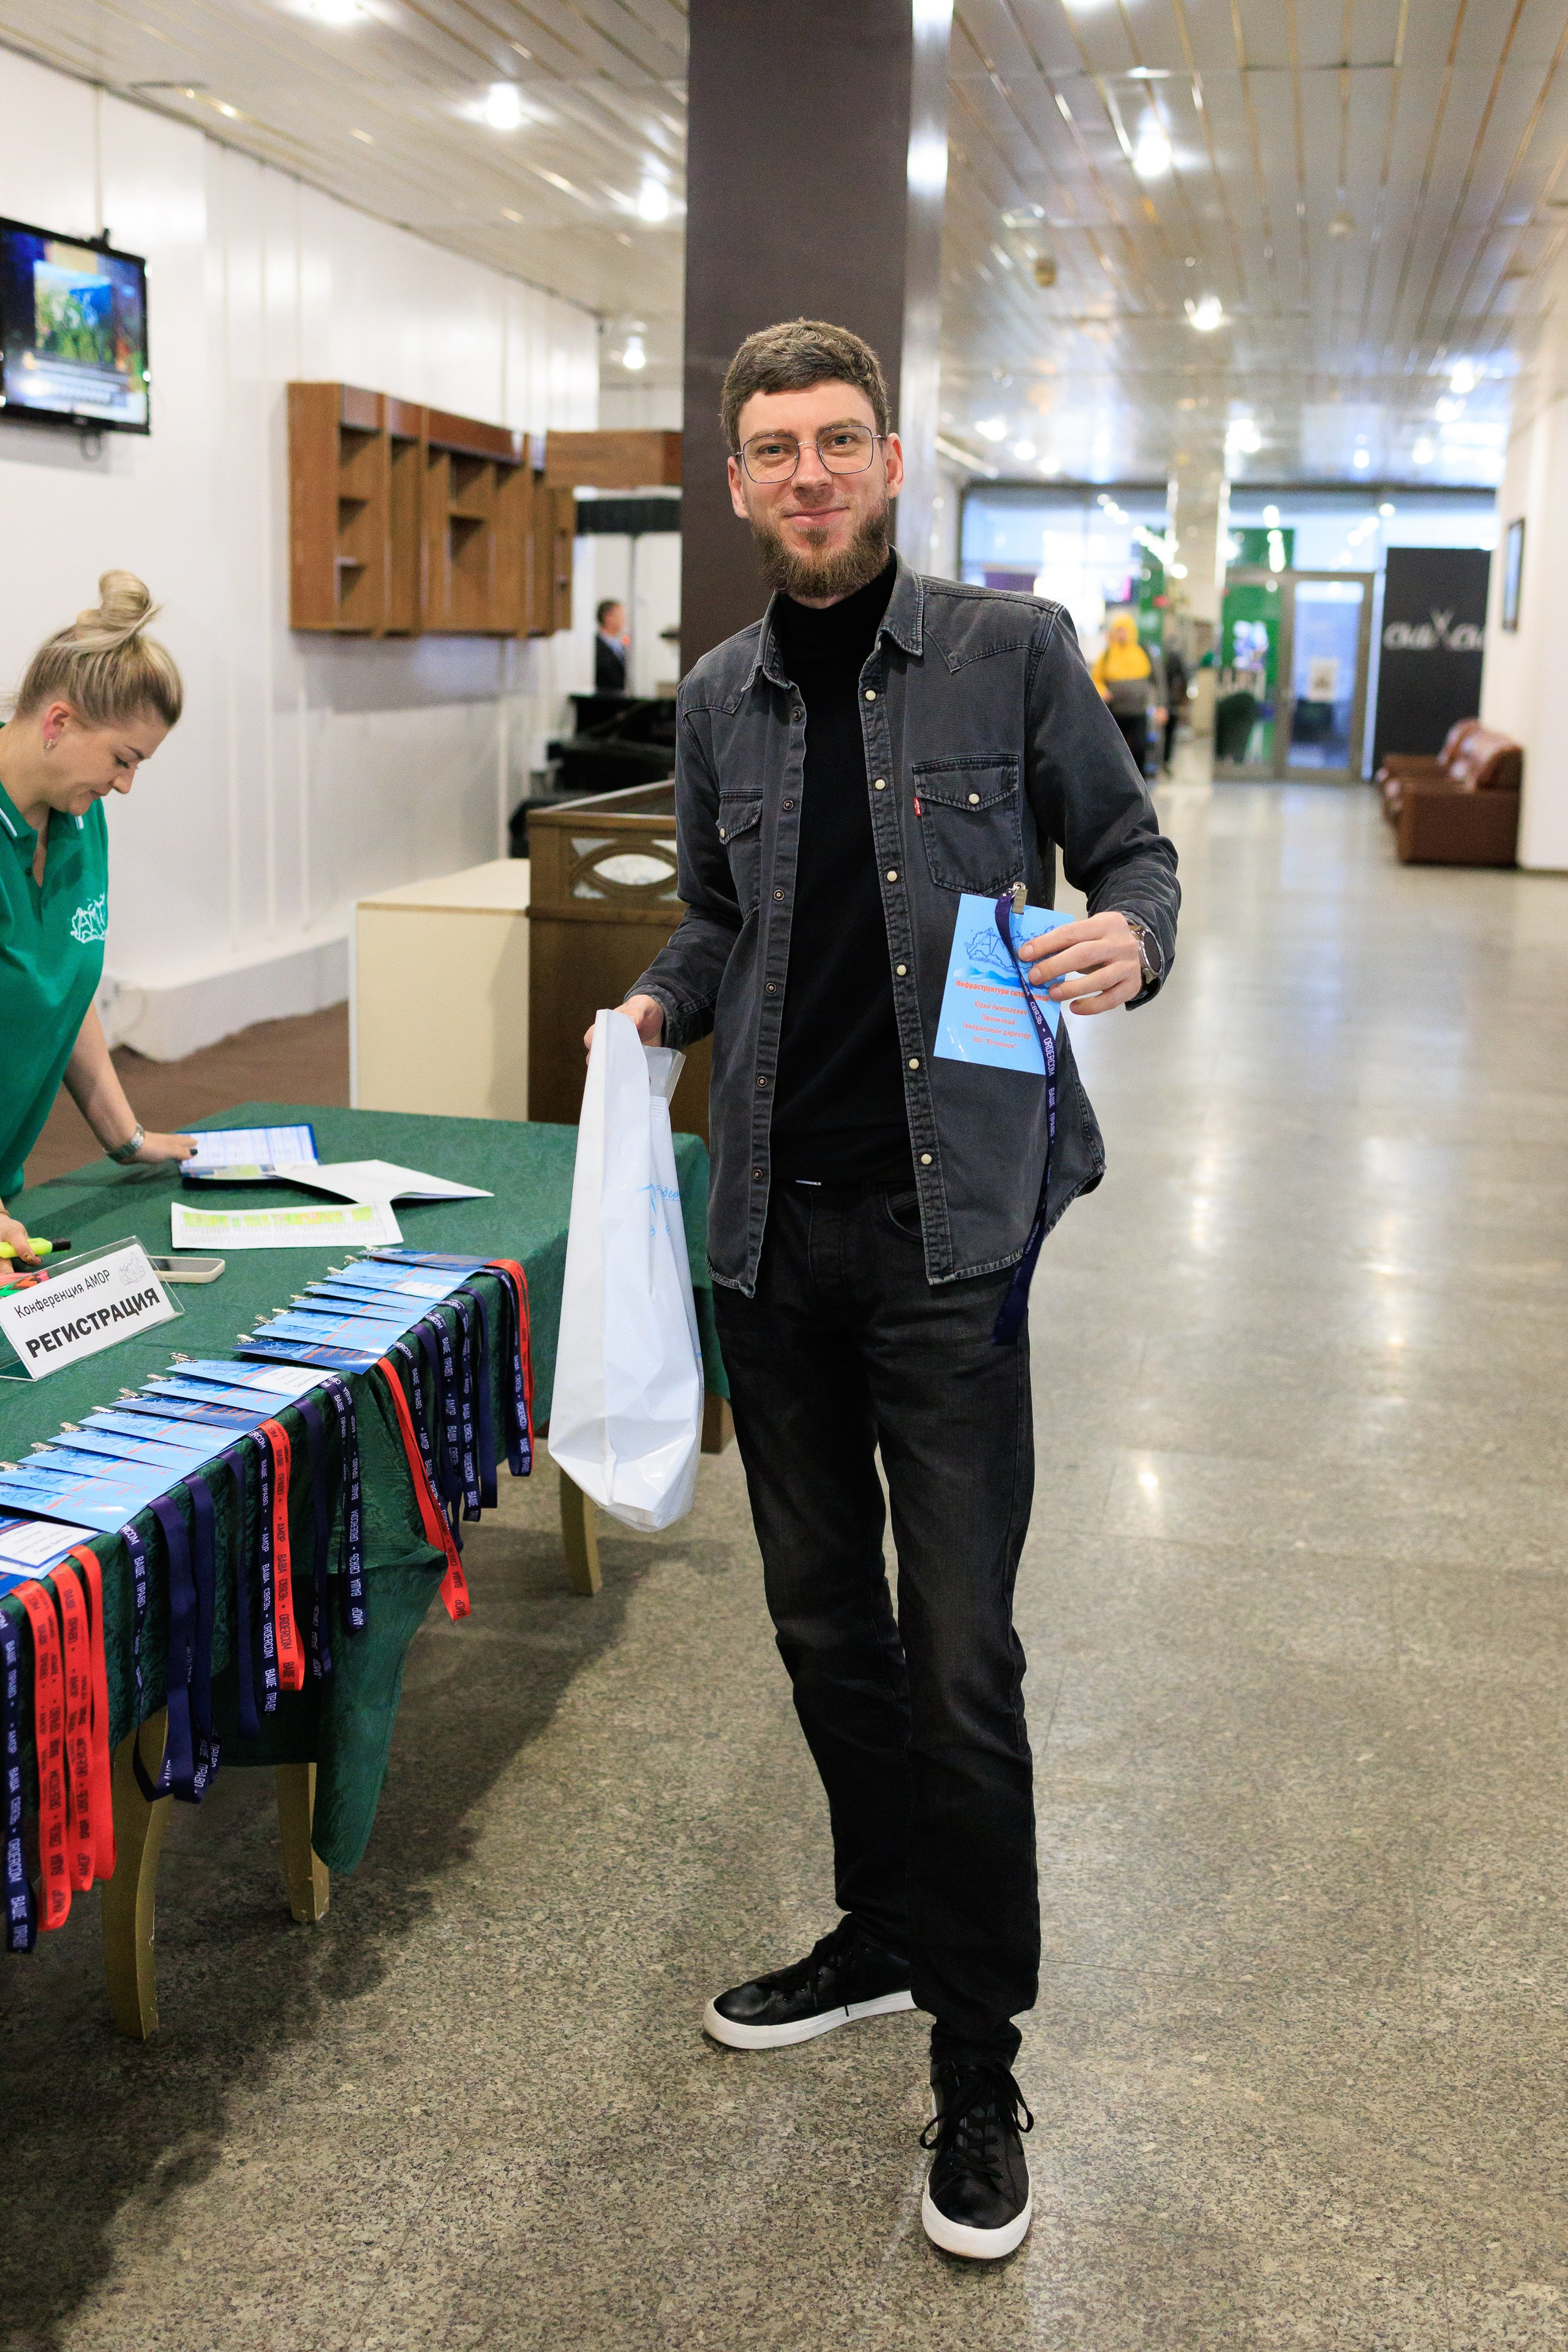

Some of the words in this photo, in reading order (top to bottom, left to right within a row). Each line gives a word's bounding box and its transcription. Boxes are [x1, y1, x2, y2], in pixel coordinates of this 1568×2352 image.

[956, 979, 1009, 995] Инфраструктура
[974, 1000, 990, 1009] Юрий
[992, 1002, 1027, 1016] Николаевич
[1030, 1001, 1042, 1025] СВЯЗЬ
[981, 1013, 1016, 1025] Пшеничный
[963, 1022, 1001, 1034] Генеральный
[1003, 1030, 1031, 1040] директор
[1044, 1038, 1055, 1076] ORDERCOM
[13, 1283, 85, 1318] Конференция
[85, 1268, 111, 1291] АМОР
[26, 1287, 160, 1359] РЕГИСТРАЦИЯ
[444, 1357, 453, 1377] ПРАВО
[334, 1394, 344, 1412] ВАШЕ
[343, 1386, 353, 1405] ВАША
[445, 1399, 456, 1415] АМОР
[420, 1432, 429, 1450] АМОР
[447, 1426, 457, 1442] ВАША
[464, 1423, 472, 1443] СВЯЗЬ
[424, 1459, 433, 1477] ВАША
[464, 1452, 475, 1483] ORDERCOM
[467, 1491, 479, 1508] ВАШЕ
[277, 1524, 285, 1542] АМОР
[350, 1509, 358, 1542] ORDERCOM
[134, 1556, 145, 1578] ВАШЕ
[277, 1554, 287, 1574] ВАША
[350, 1553, 359, 1574] СВЯЗЬ
[278, 1578, 288, 1601] СВЯЗЬ
[351, 1578, 361, 1596] ВАША
[454, 1572, 463, 1588] ВАША
[137, 1581, 146, 1608] ПРАВО
[353, 1607, 364, 1626] АМОР
[457, 1599, 466, 1617] АМОР
[263, 1623, 274, 1659] ORDERCOM
[279, 1613, 292, 1650] ORDERCOM
[5, 1640, 17, 1666] ВАШЕ
[265, 1668, 277, 1689] ВАШЕ
[313, 1659, 322, 1678] АМОР
[8, 1669, 17, 1698] ПРАВО
[265, 1692, 277, 1712] ПРАВО
[8, 1730, 17, 1754] АМОР
[9, 1766, 20, 1793] ВАША
[10, 1796, 21, 1825] СВЯЗЬ
[8, 1838, 22, 1883] ORDERCOM
[10, 1895, 27, 1921] ВАШЕ
